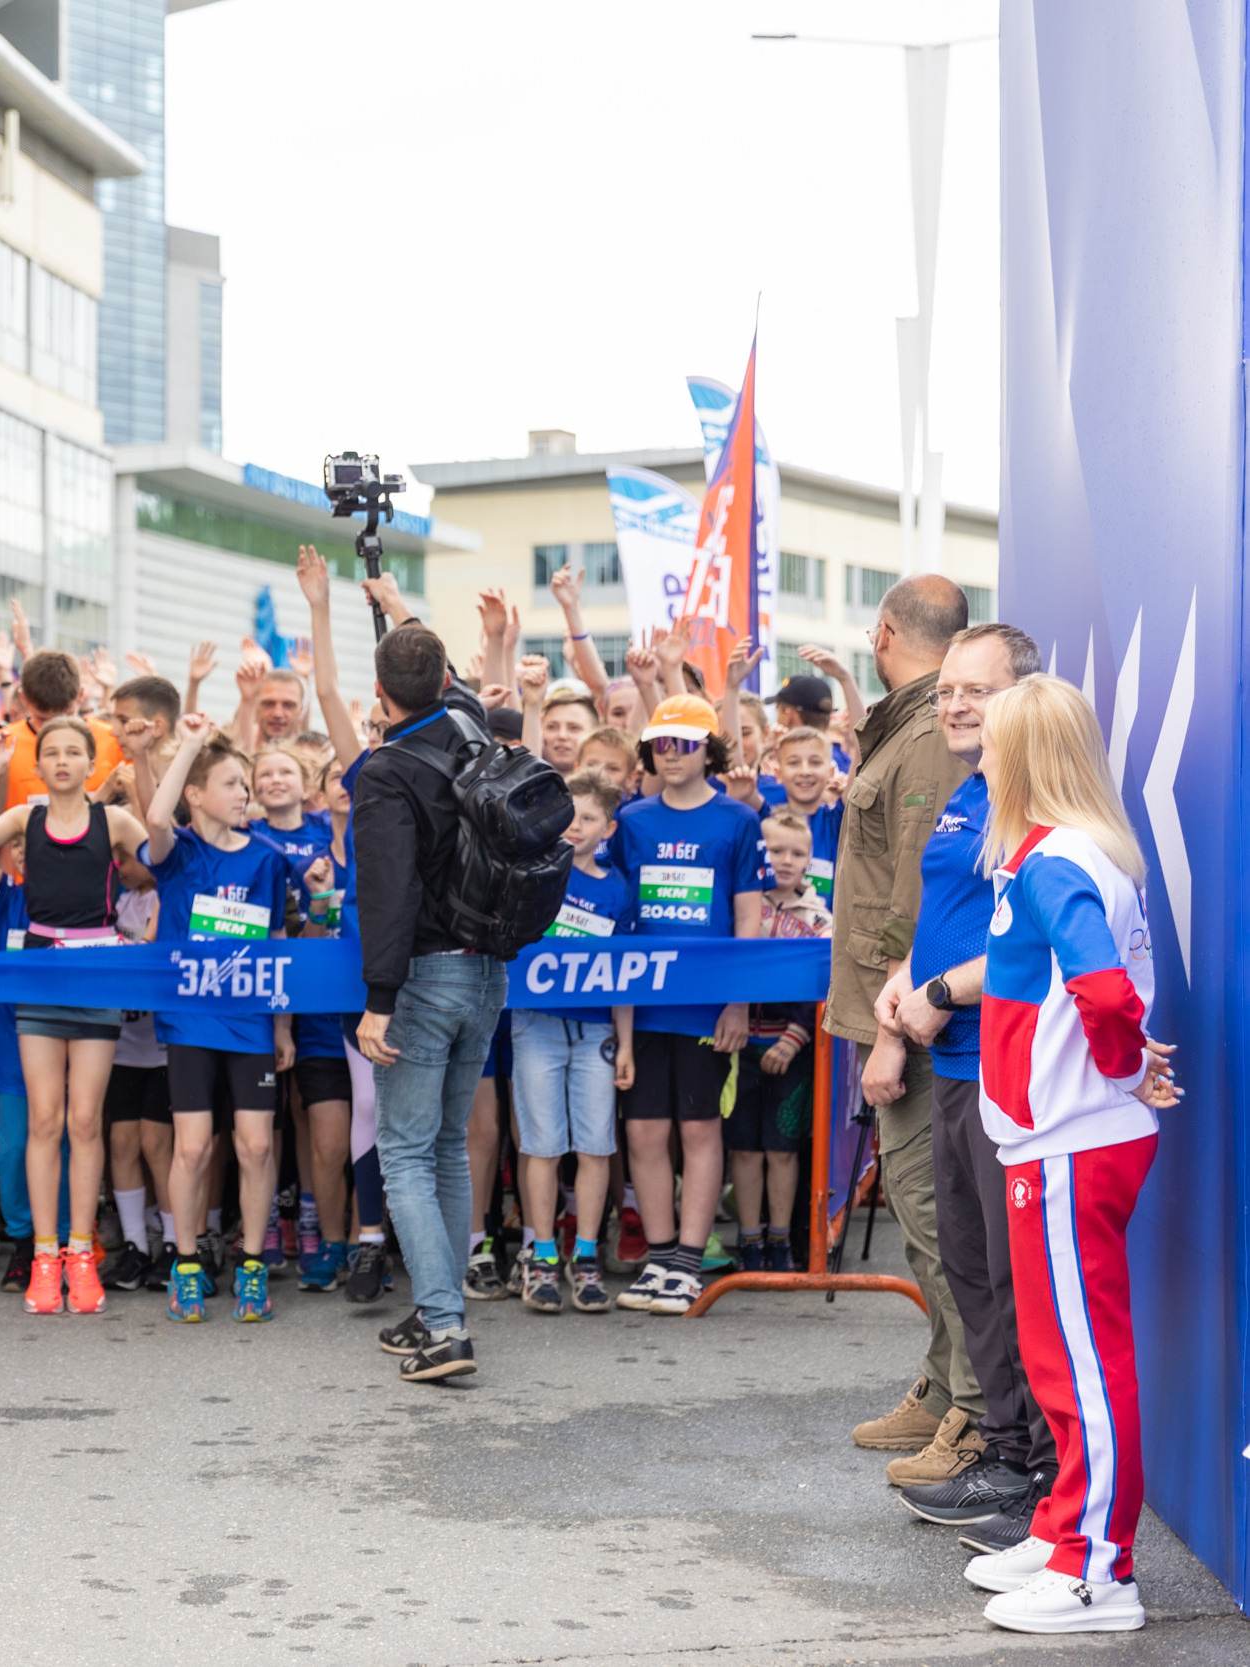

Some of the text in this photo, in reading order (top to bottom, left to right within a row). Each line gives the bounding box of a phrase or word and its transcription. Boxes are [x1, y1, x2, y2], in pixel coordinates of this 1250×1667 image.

[656, 840, 700, 861] ЗАБЕГ
[639, 903, 708, 921] 20404
[525, 950, 680, 995] СТАРТ
